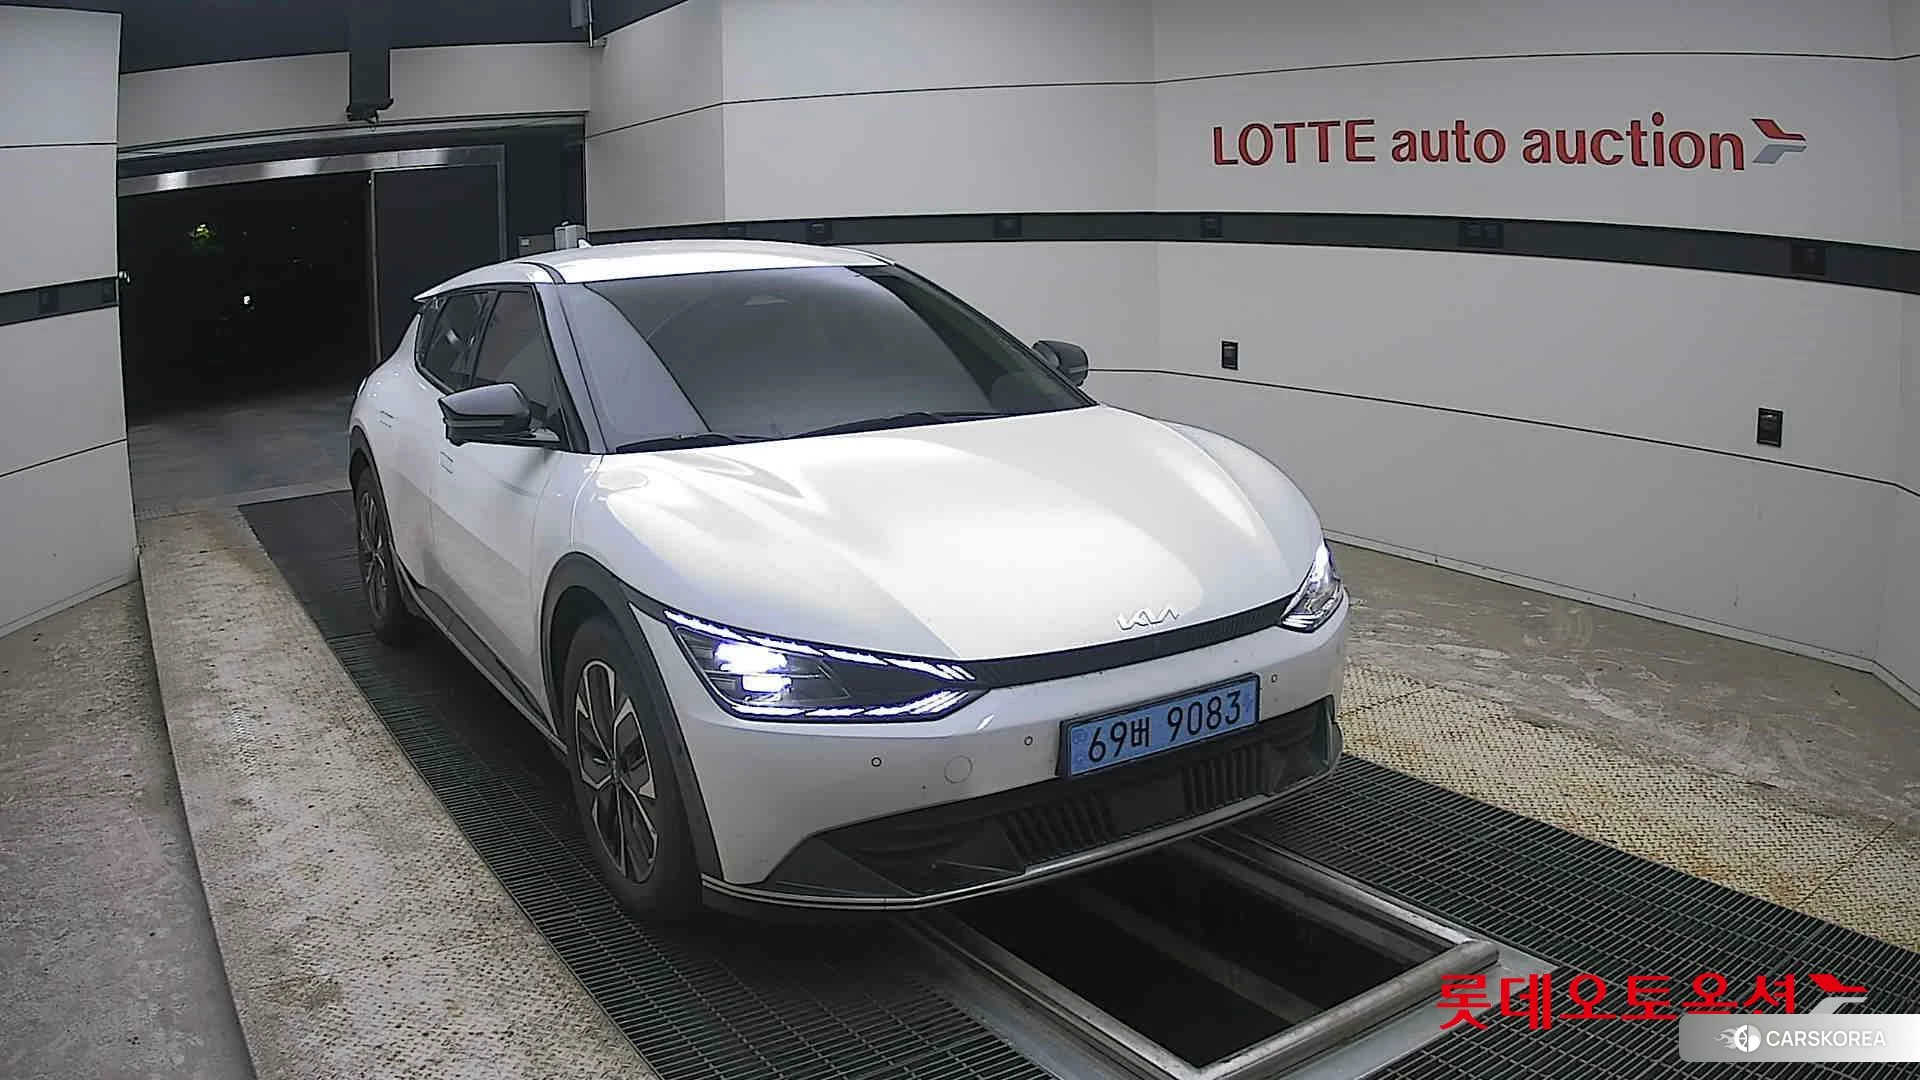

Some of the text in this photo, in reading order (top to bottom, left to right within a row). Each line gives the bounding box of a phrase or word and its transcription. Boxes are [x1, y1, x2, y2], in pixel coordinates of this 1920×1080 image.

[1212, 112, 1744, 170] LOTTE auto auction
[1088, 691, 1241, 762] 69버 9083
